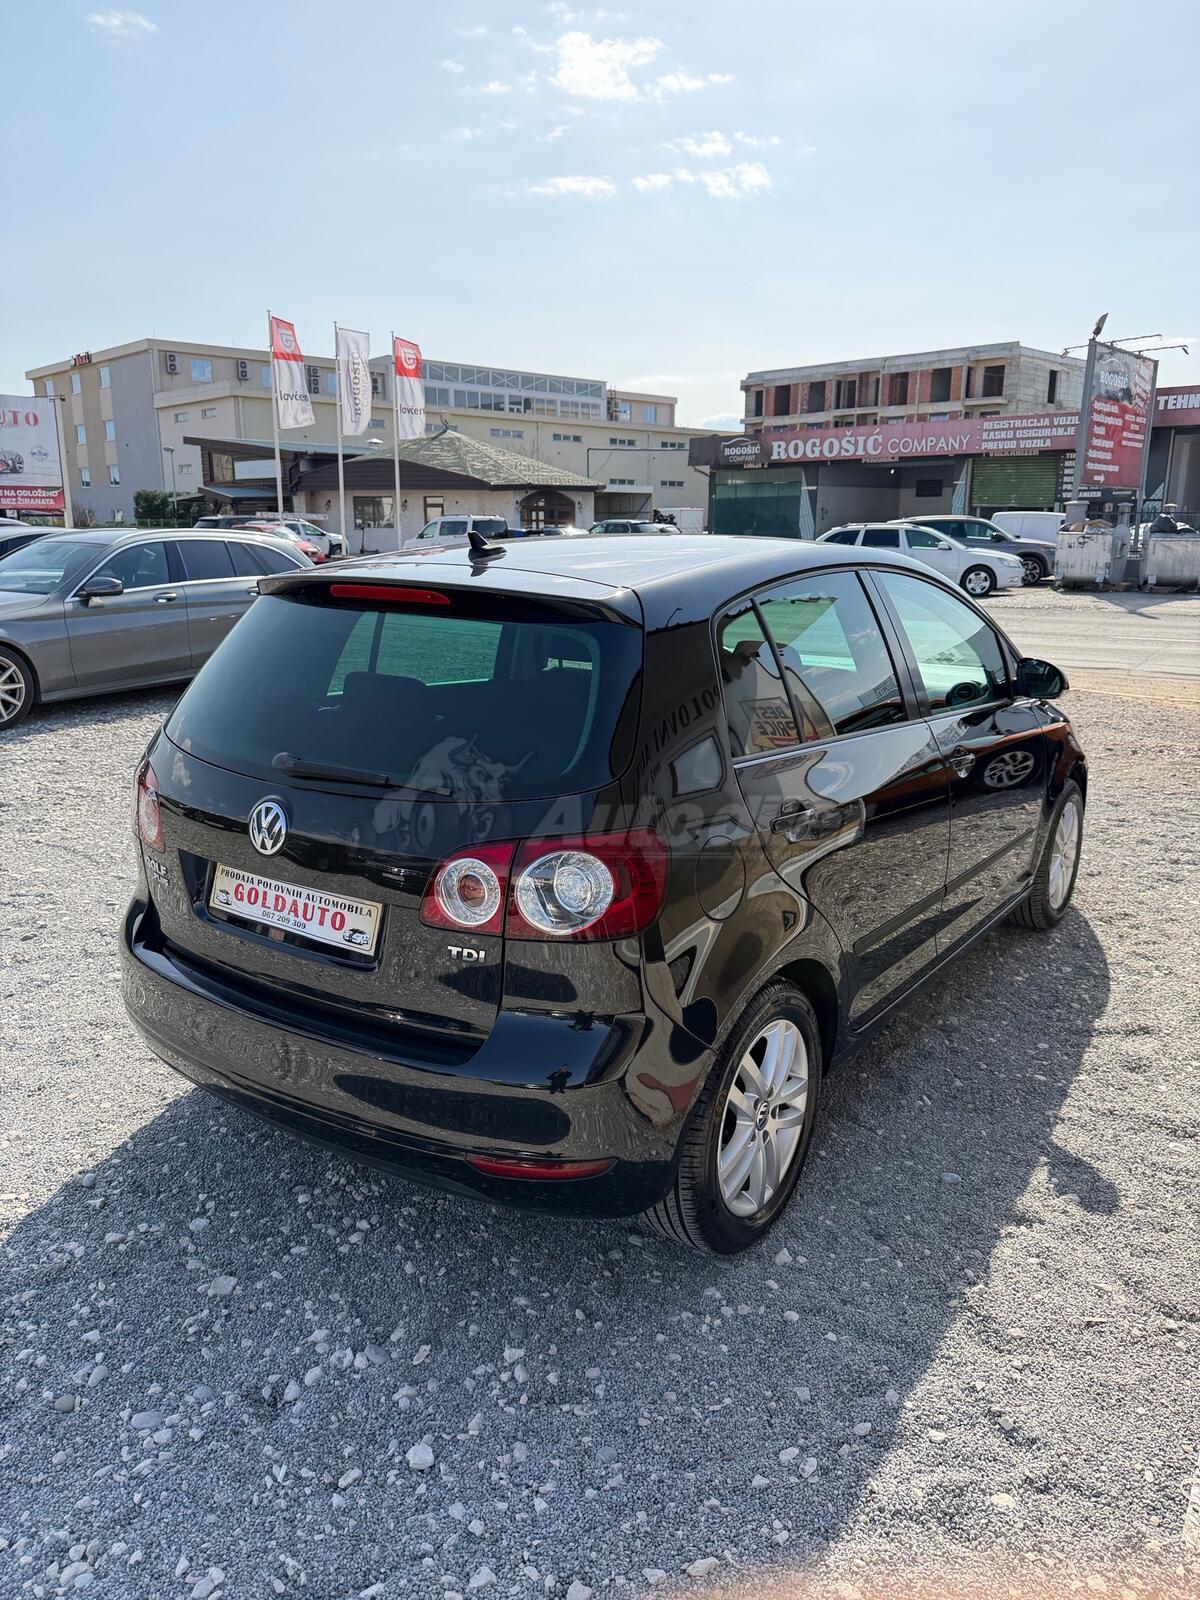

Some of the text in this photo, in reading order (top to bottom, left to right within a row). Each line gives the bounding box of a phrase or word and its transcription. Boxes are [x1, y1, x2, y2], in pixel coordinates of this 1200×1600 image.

[279, 389, 309, 402] lovćen
[983, 418, 1049, 430] REGISTRACIJA
[1053, 415, 1080, 426] VOZIL
[982, 426, 1077, 440] KASKO OSIGURANJE
[724, 443, 761, 456] ROGOŠIĆ
[771, 428, 970, 460] ROGOŠIĆ COMPANY
[981, 438, 1051, 450] PREVOD VOZILA
[4, 489, 16, 497] NA
[220, 867, 373, 918] PRODAJA POLOVNIH AUTOMOBILA
[233, 882, 346, 932] GOLDAUTO
[261, 910, 307, 930] 067 209 309
[447, 945, 486, 963] TDI
